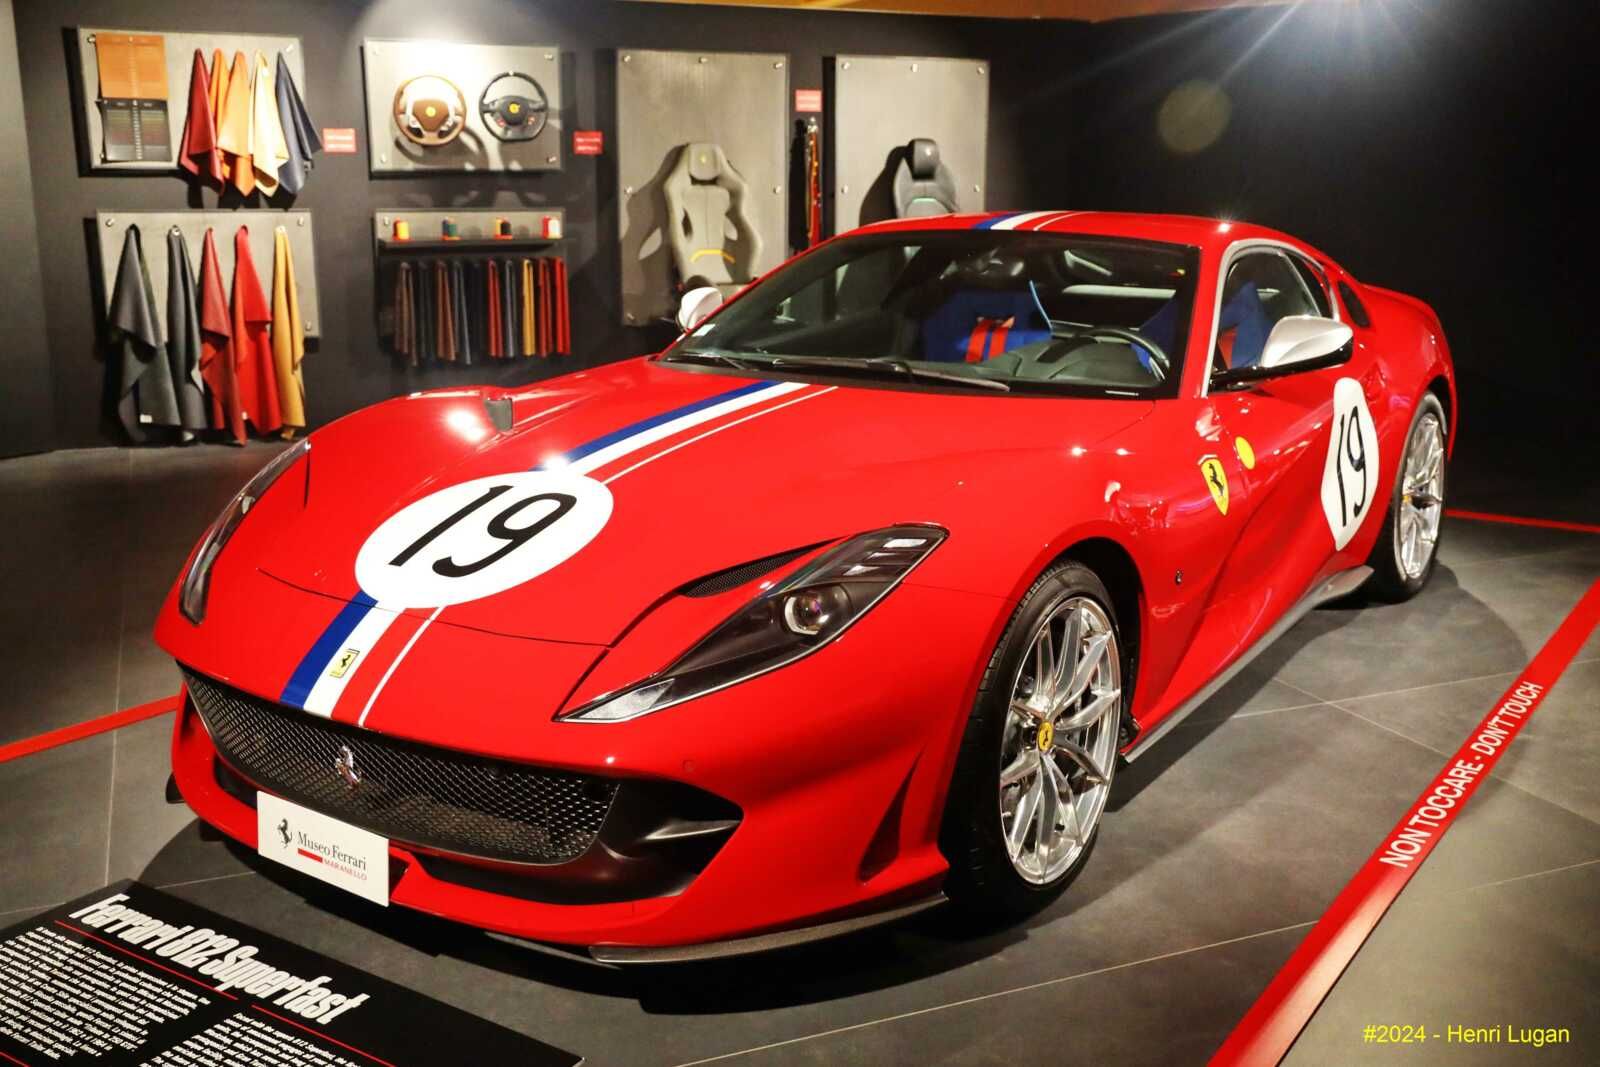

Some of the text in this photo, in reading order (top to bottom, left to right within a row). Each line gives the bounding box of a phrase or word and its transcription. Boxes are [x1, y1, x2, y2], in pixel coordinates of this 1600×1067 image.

[1337, 406, 1367, 527] 19
[388, 485, 577, 578] 19
[1379, 827, 1432, 868] NON
[1408, 759, 1484, 827] TOCCARE
[1470, 715, 1515, 756] DON'T
[1498, 681, 1543, 719] TOUCH
[298, 831, 367, 871] Museo Ferrari
[324, 858, 367, 880] MARANELLO
[69, 893, 195, 950] Ferrari
[155, 928, 240, 968] 812
[198, 945, 371, 1025] Superfast
